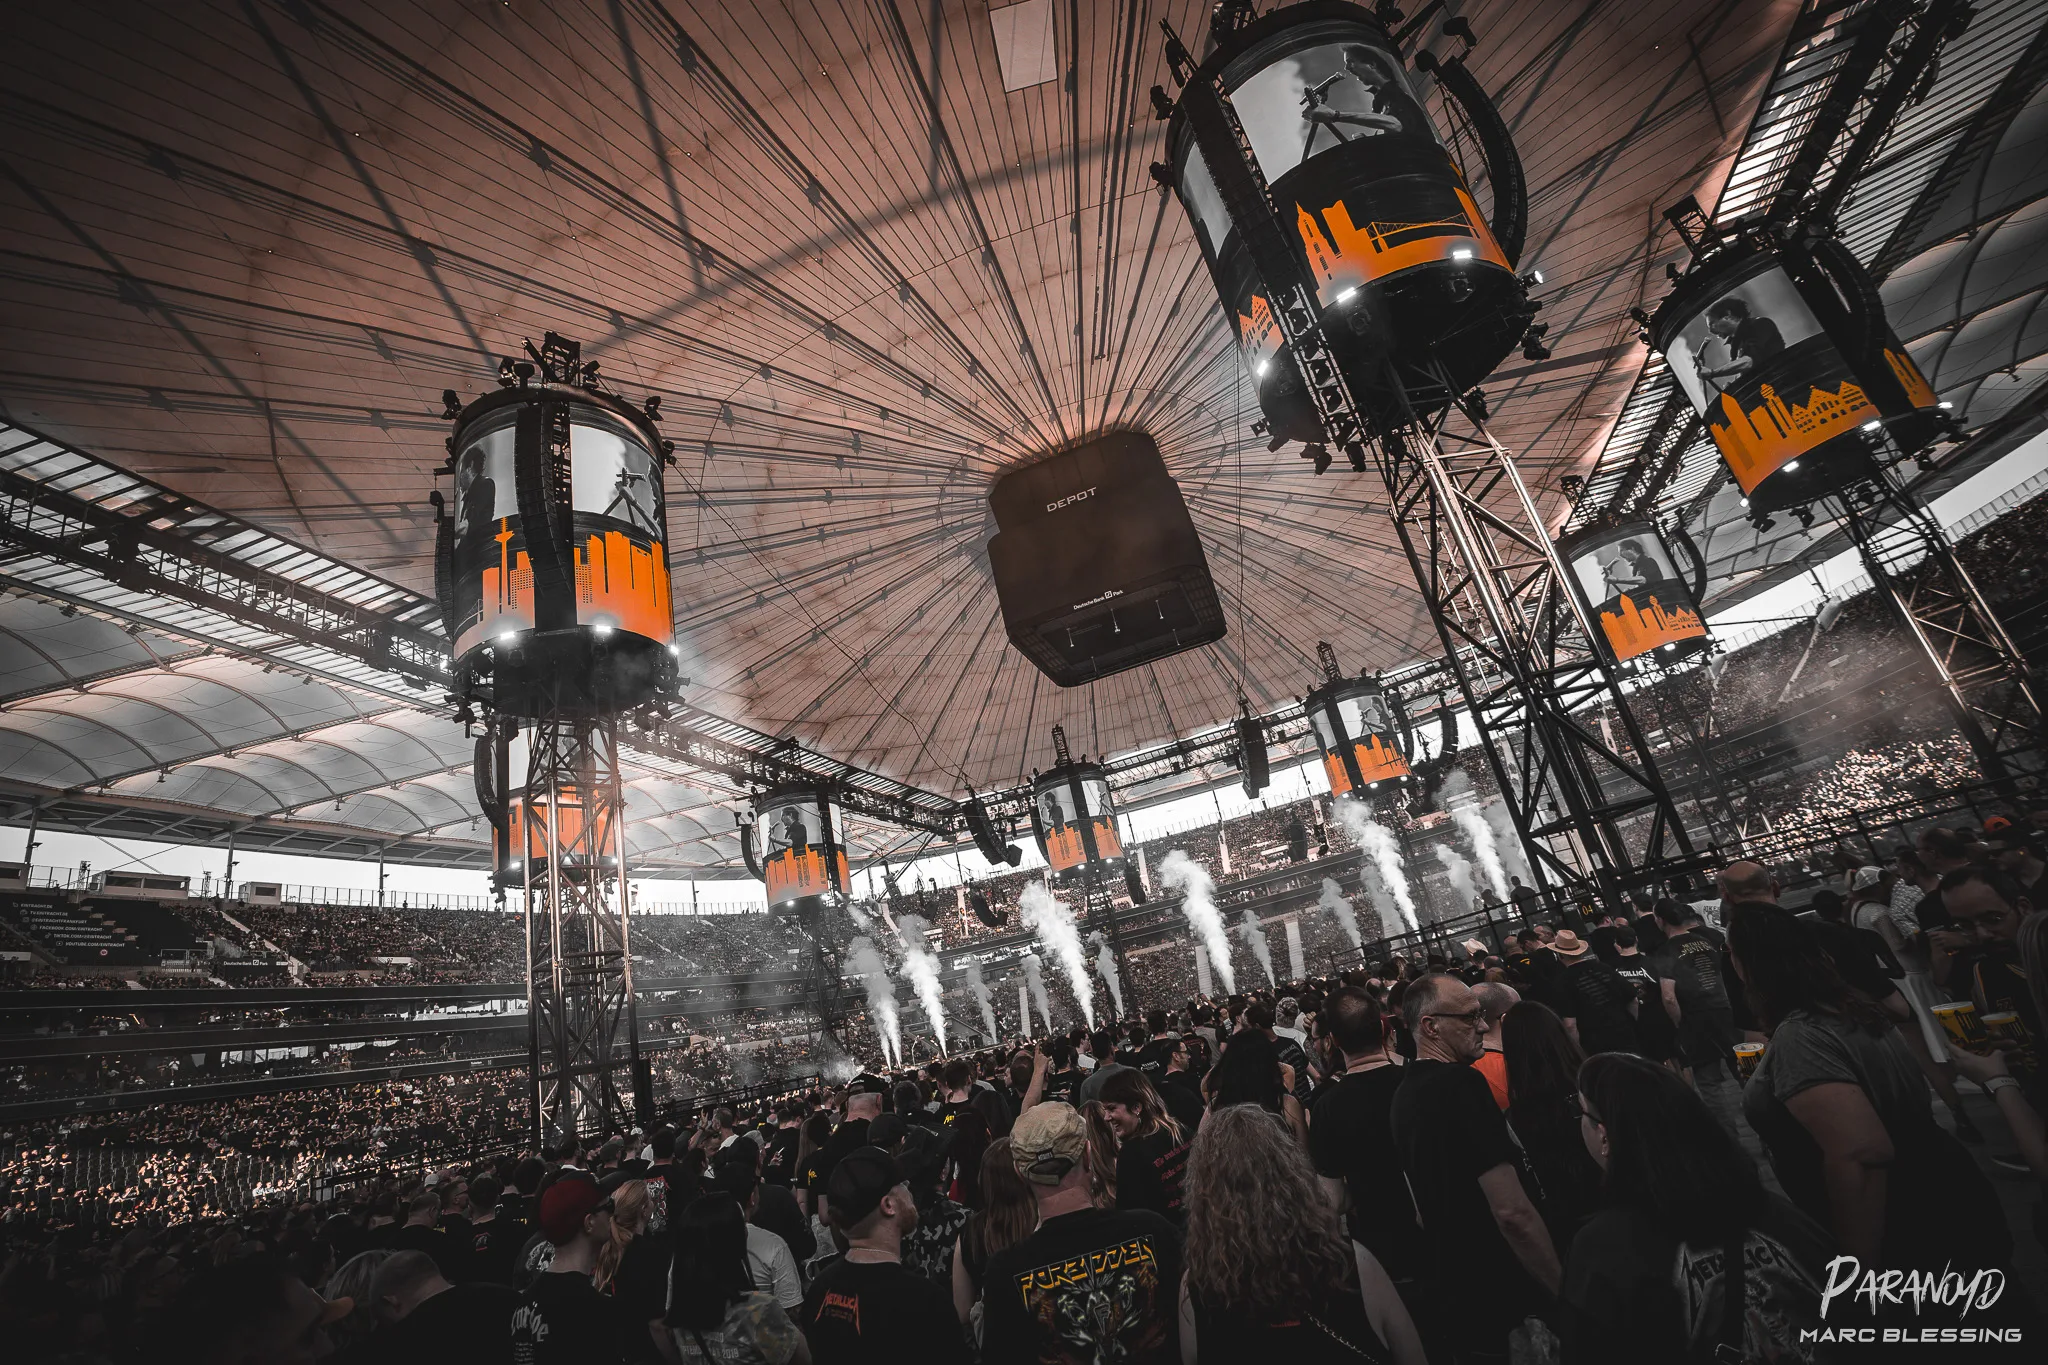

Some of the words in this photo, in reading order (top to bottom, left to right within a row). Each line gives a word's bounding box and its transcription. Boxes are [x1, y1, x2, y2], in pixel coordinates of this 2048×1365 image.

[1046, 486, 1098, 513] DEPOT
[1073, 600, 1094, 610] Deutsche
[1093, 596, 1106, 604] Bank
[1582, 904, 1594, 916] 04
[814, 1287, 862, 1336] METALLICA
[721, 1347, 740, 1360] 2019
